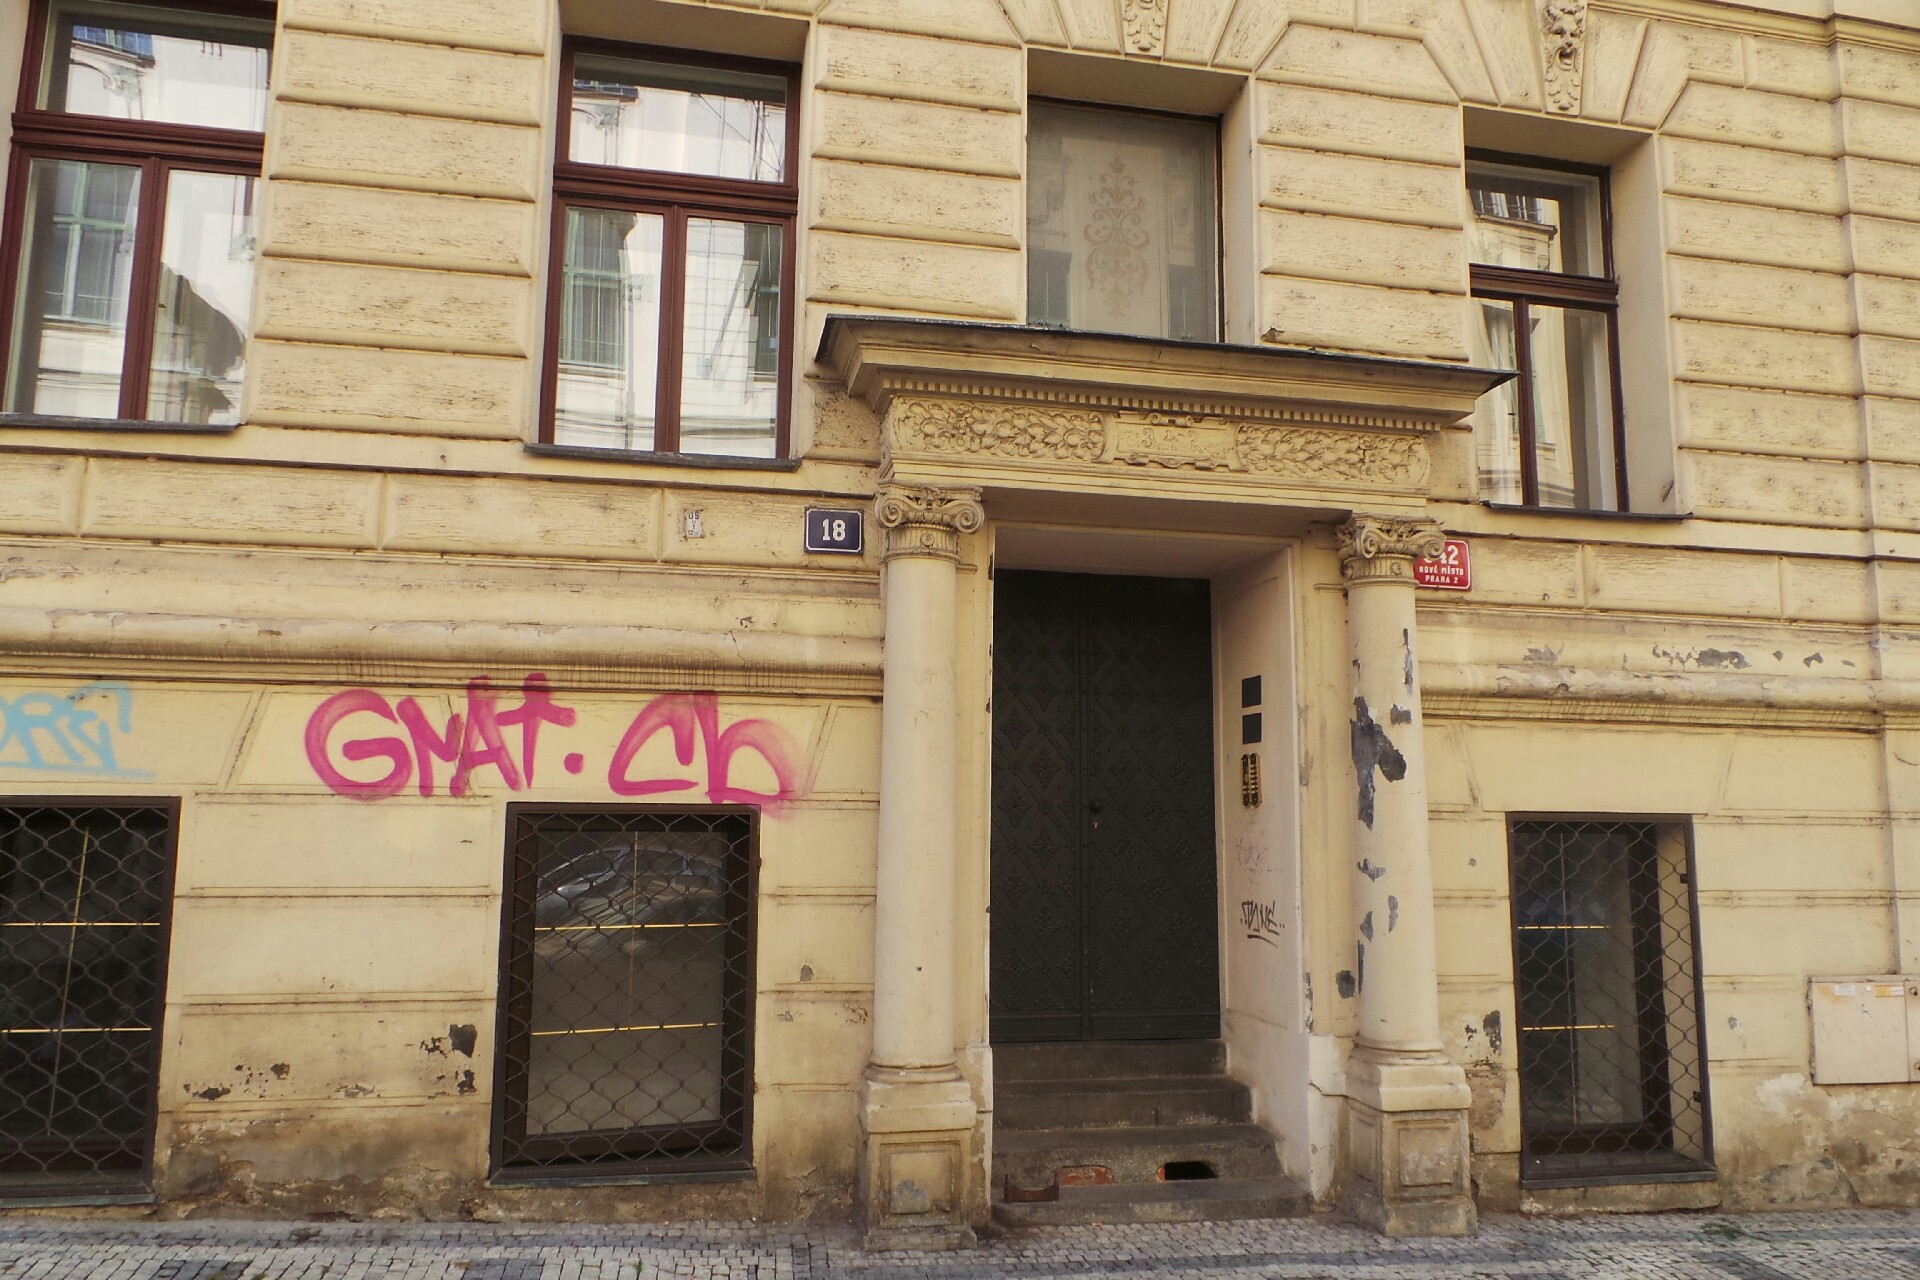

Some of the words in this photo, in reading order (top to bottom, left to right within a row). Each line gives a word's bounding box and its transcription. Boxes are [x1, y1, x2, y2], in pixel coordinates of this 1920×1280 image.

[822, 518, 846, 541] 18
[1419, 564, 1438, 574] NOVÉ
[1425, 575, 1450, 584] PRAHA
